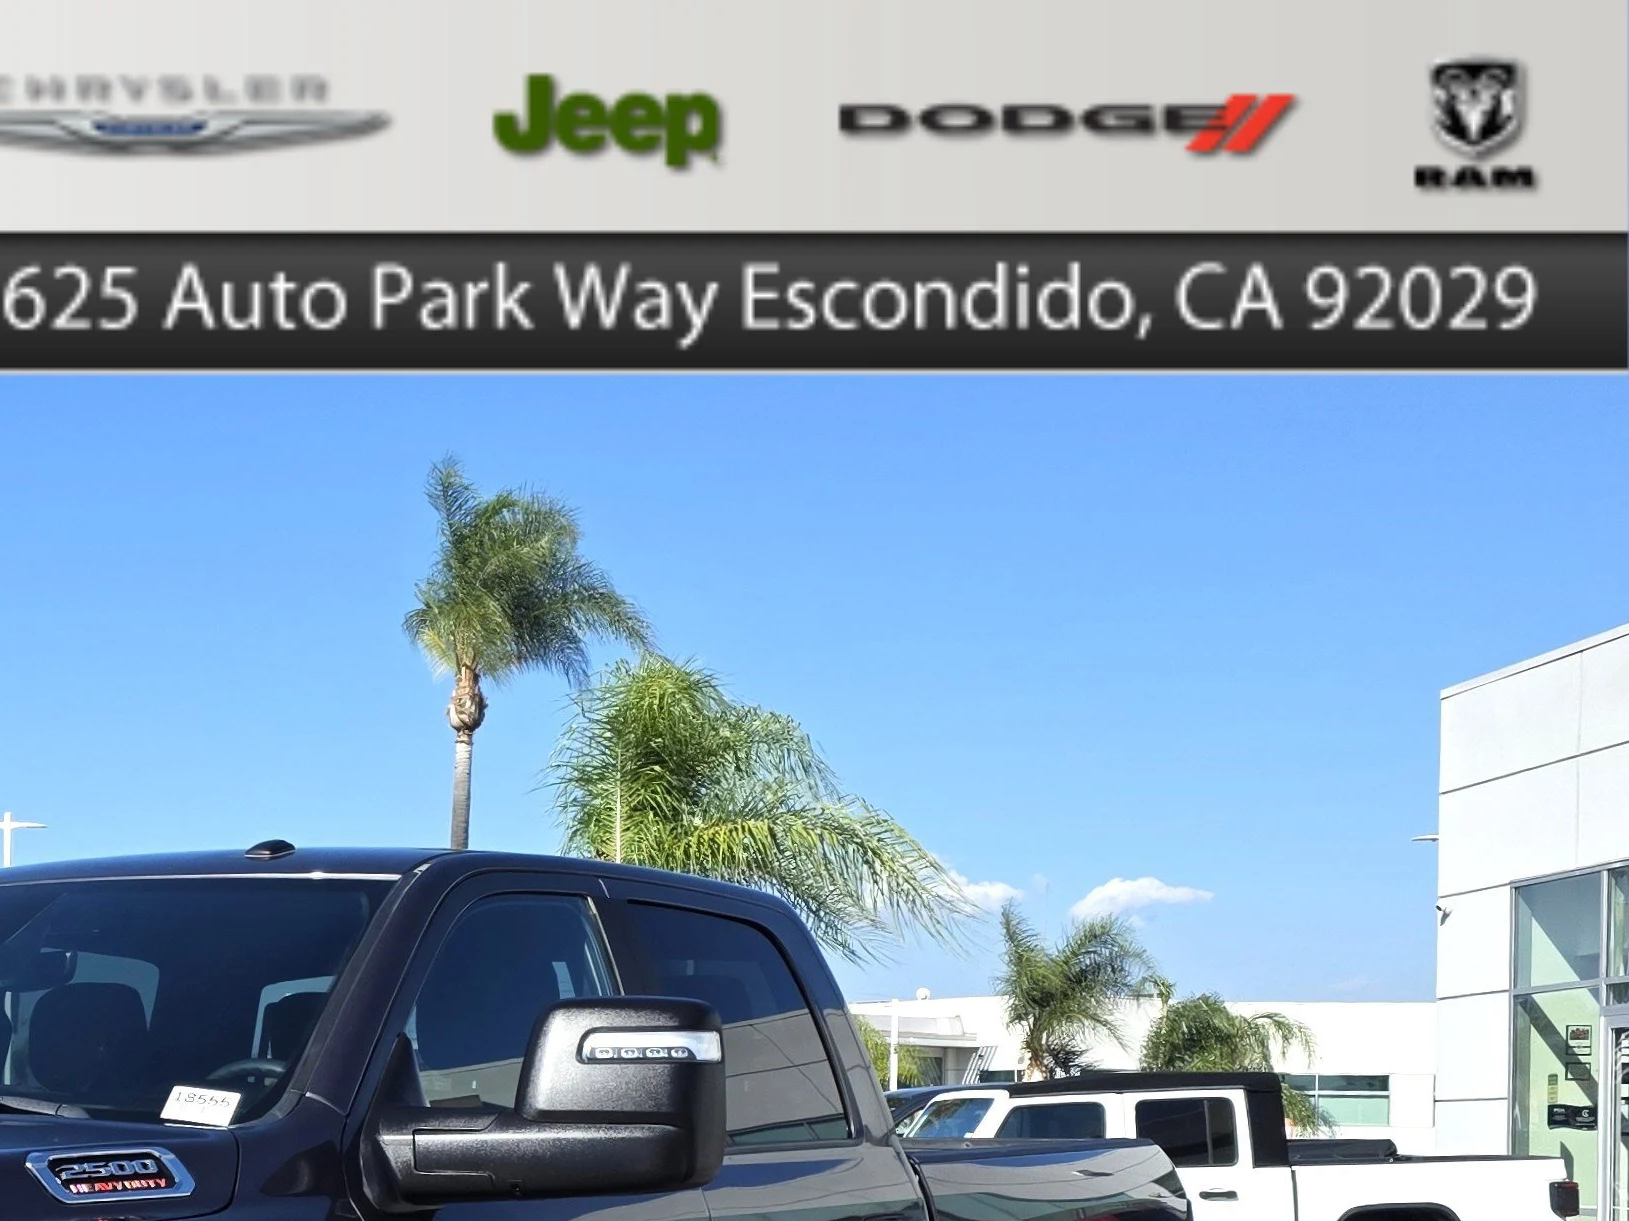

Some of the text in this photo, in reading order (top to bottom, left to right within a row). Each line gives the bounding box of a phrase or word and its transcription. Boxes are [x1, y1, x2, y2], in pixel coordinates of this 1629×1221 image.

[56, 1159, 160, 1180] 2500
[69, 1178, 167, 1194] HEAVY DUTY
